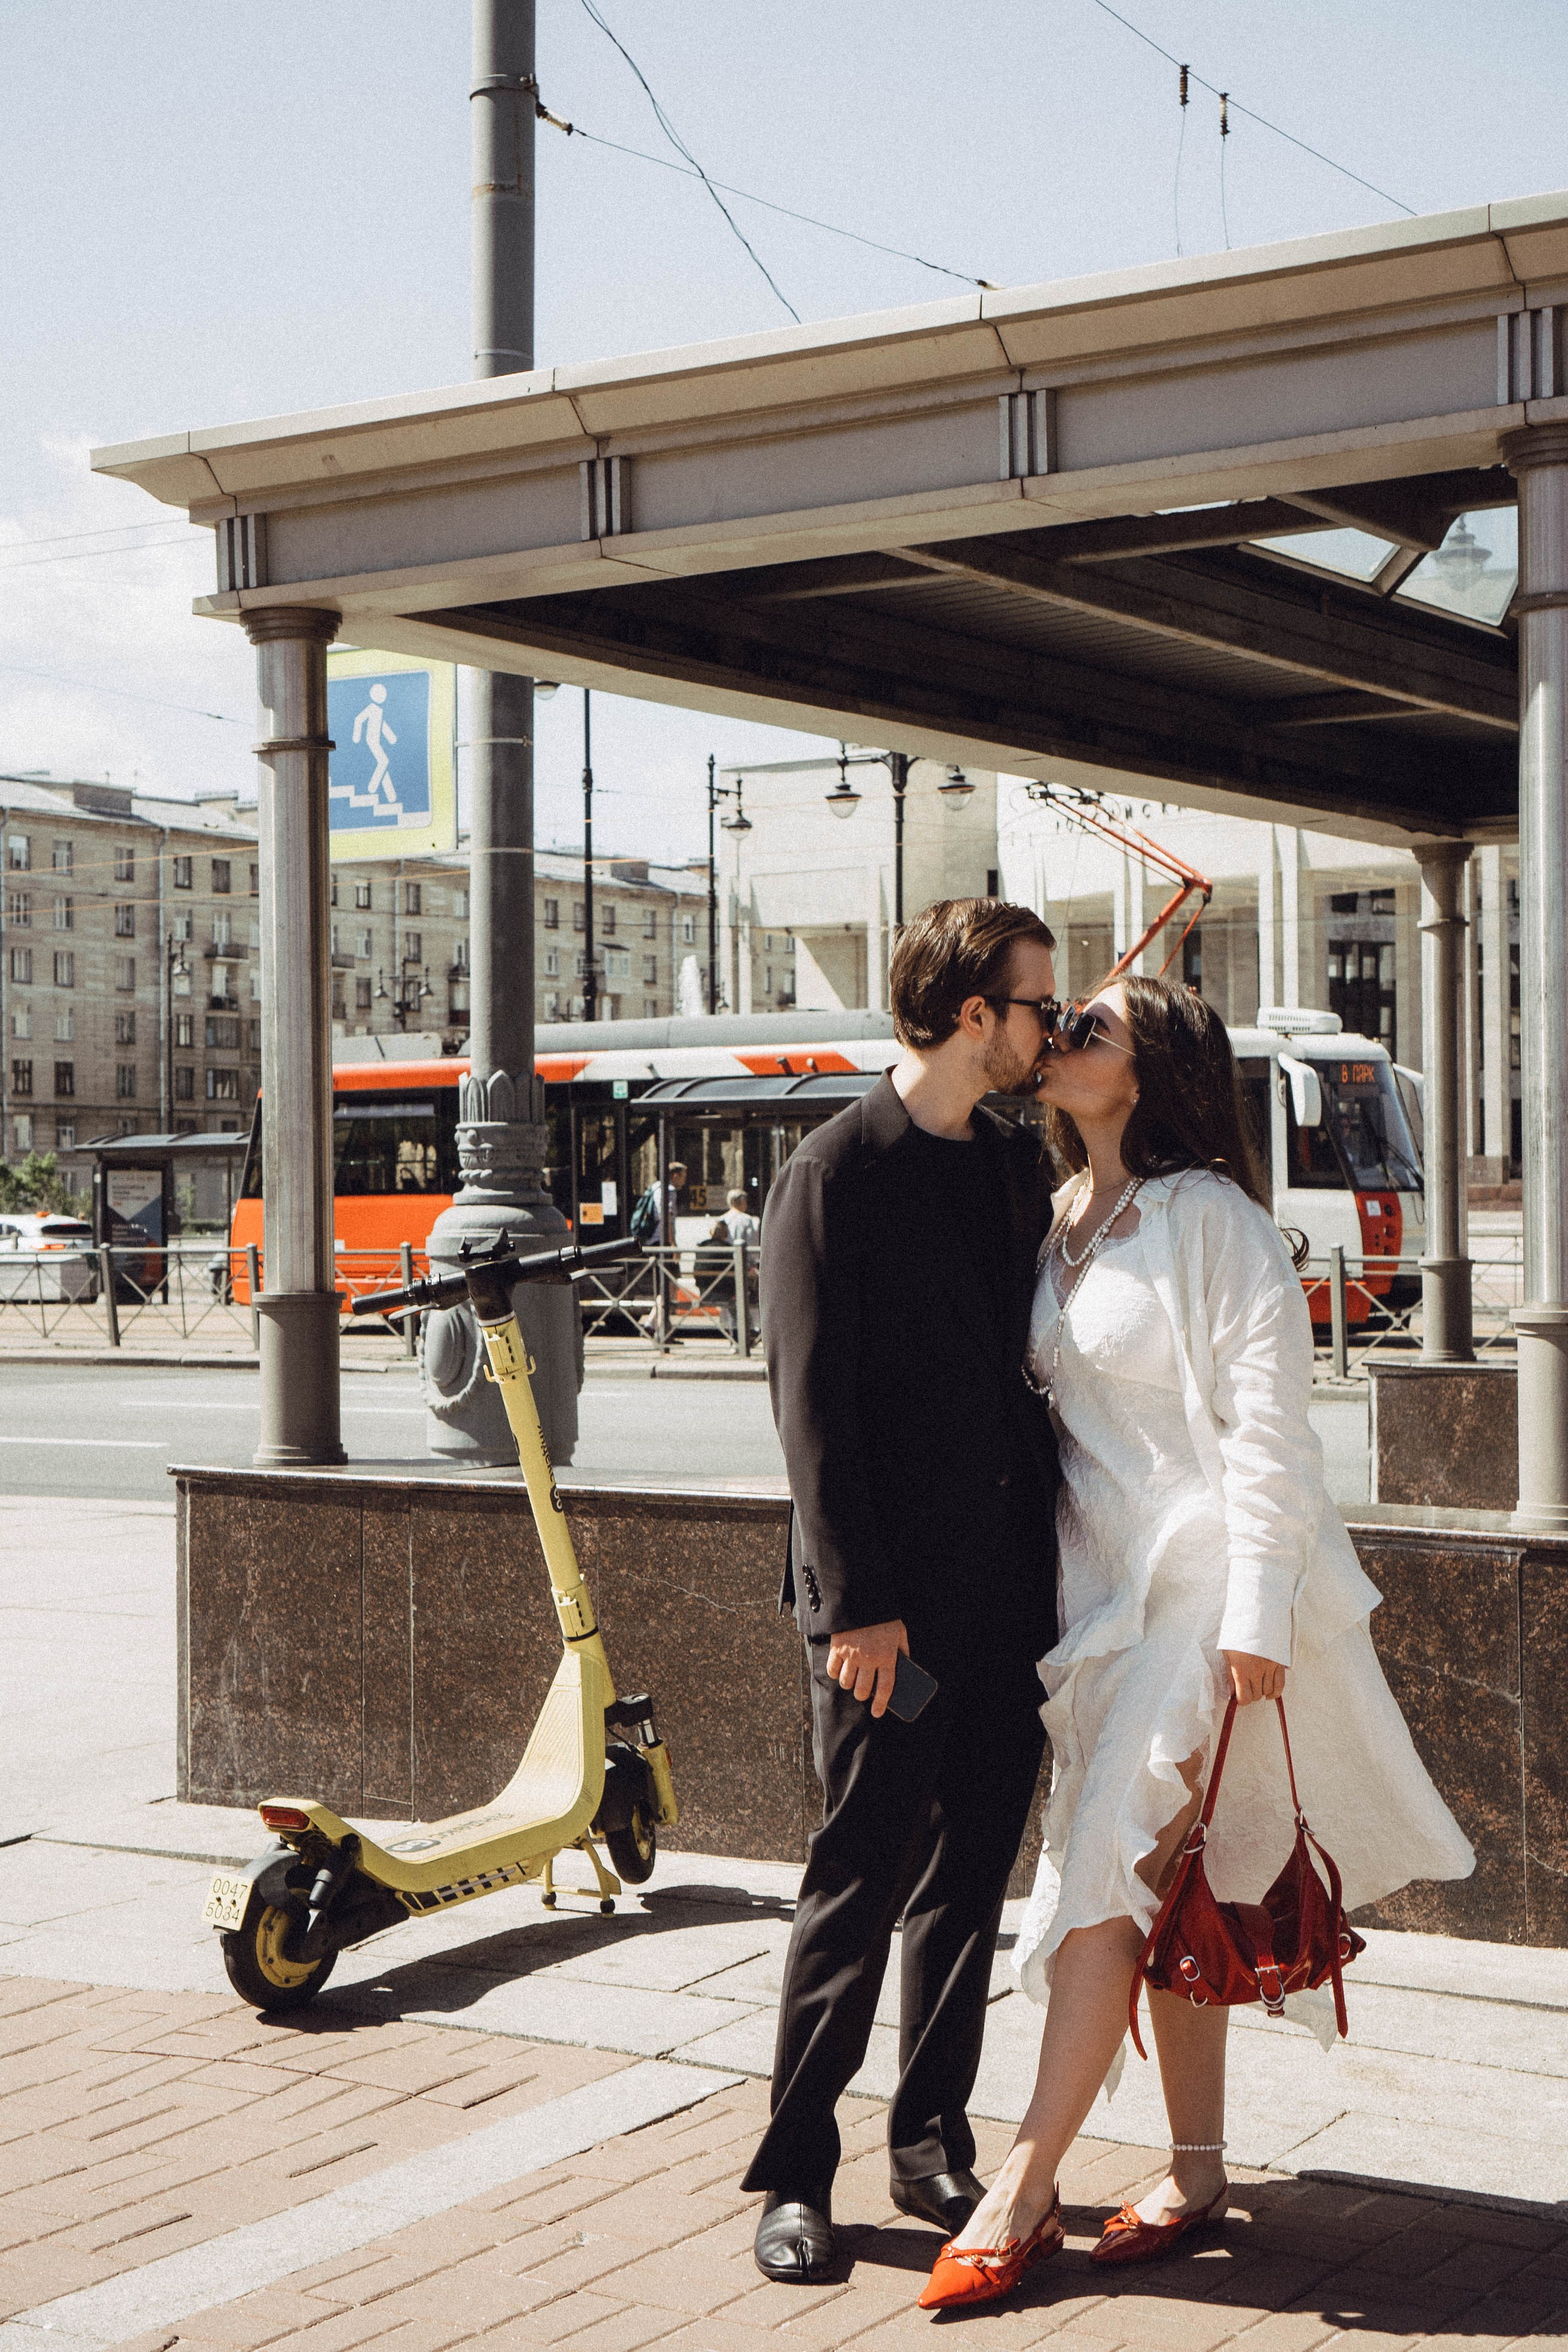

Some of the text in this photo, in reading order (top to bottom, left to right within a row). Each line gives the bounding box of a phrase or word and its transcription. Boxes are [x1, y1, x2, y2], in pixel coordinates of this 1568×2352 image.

[1352, 1063, 1375, 1083] ПАРК
[213, 1878, 248, 1899] 0047
[205, 1902, 240, 1923] 5034
